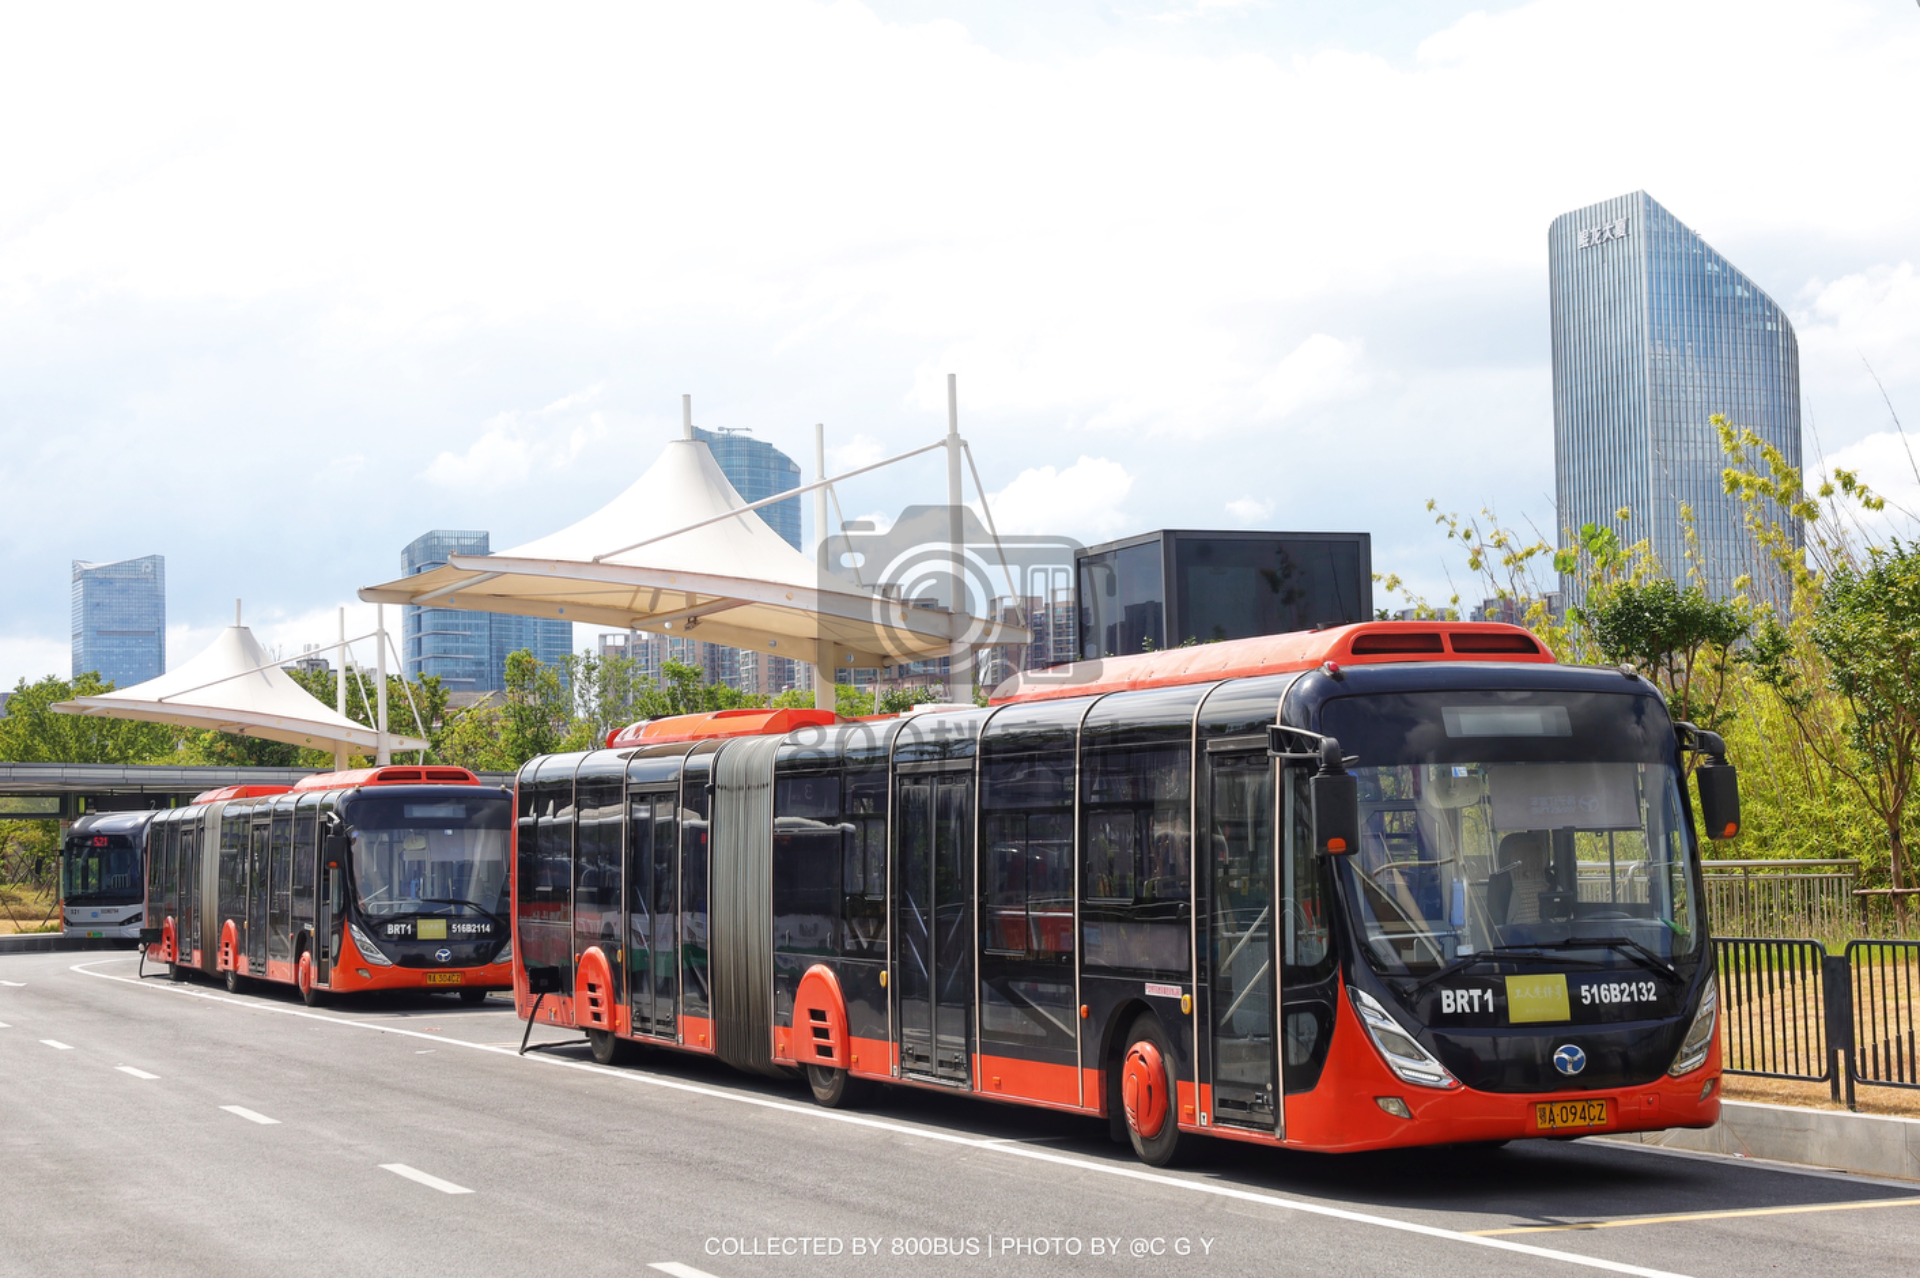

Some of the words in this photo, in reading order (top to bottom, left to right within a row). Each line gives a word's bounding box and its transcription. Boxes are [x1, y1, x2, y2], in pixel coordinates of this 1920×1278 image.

[93, 836, 108, 847] 521
[387, 924, 412, 935] BRT1
[451, 923, 491, 933] 516B2114
[1580, 981, 1657, 1005] 516B2132
[1441, 988, 1494, 1014] BRT1
